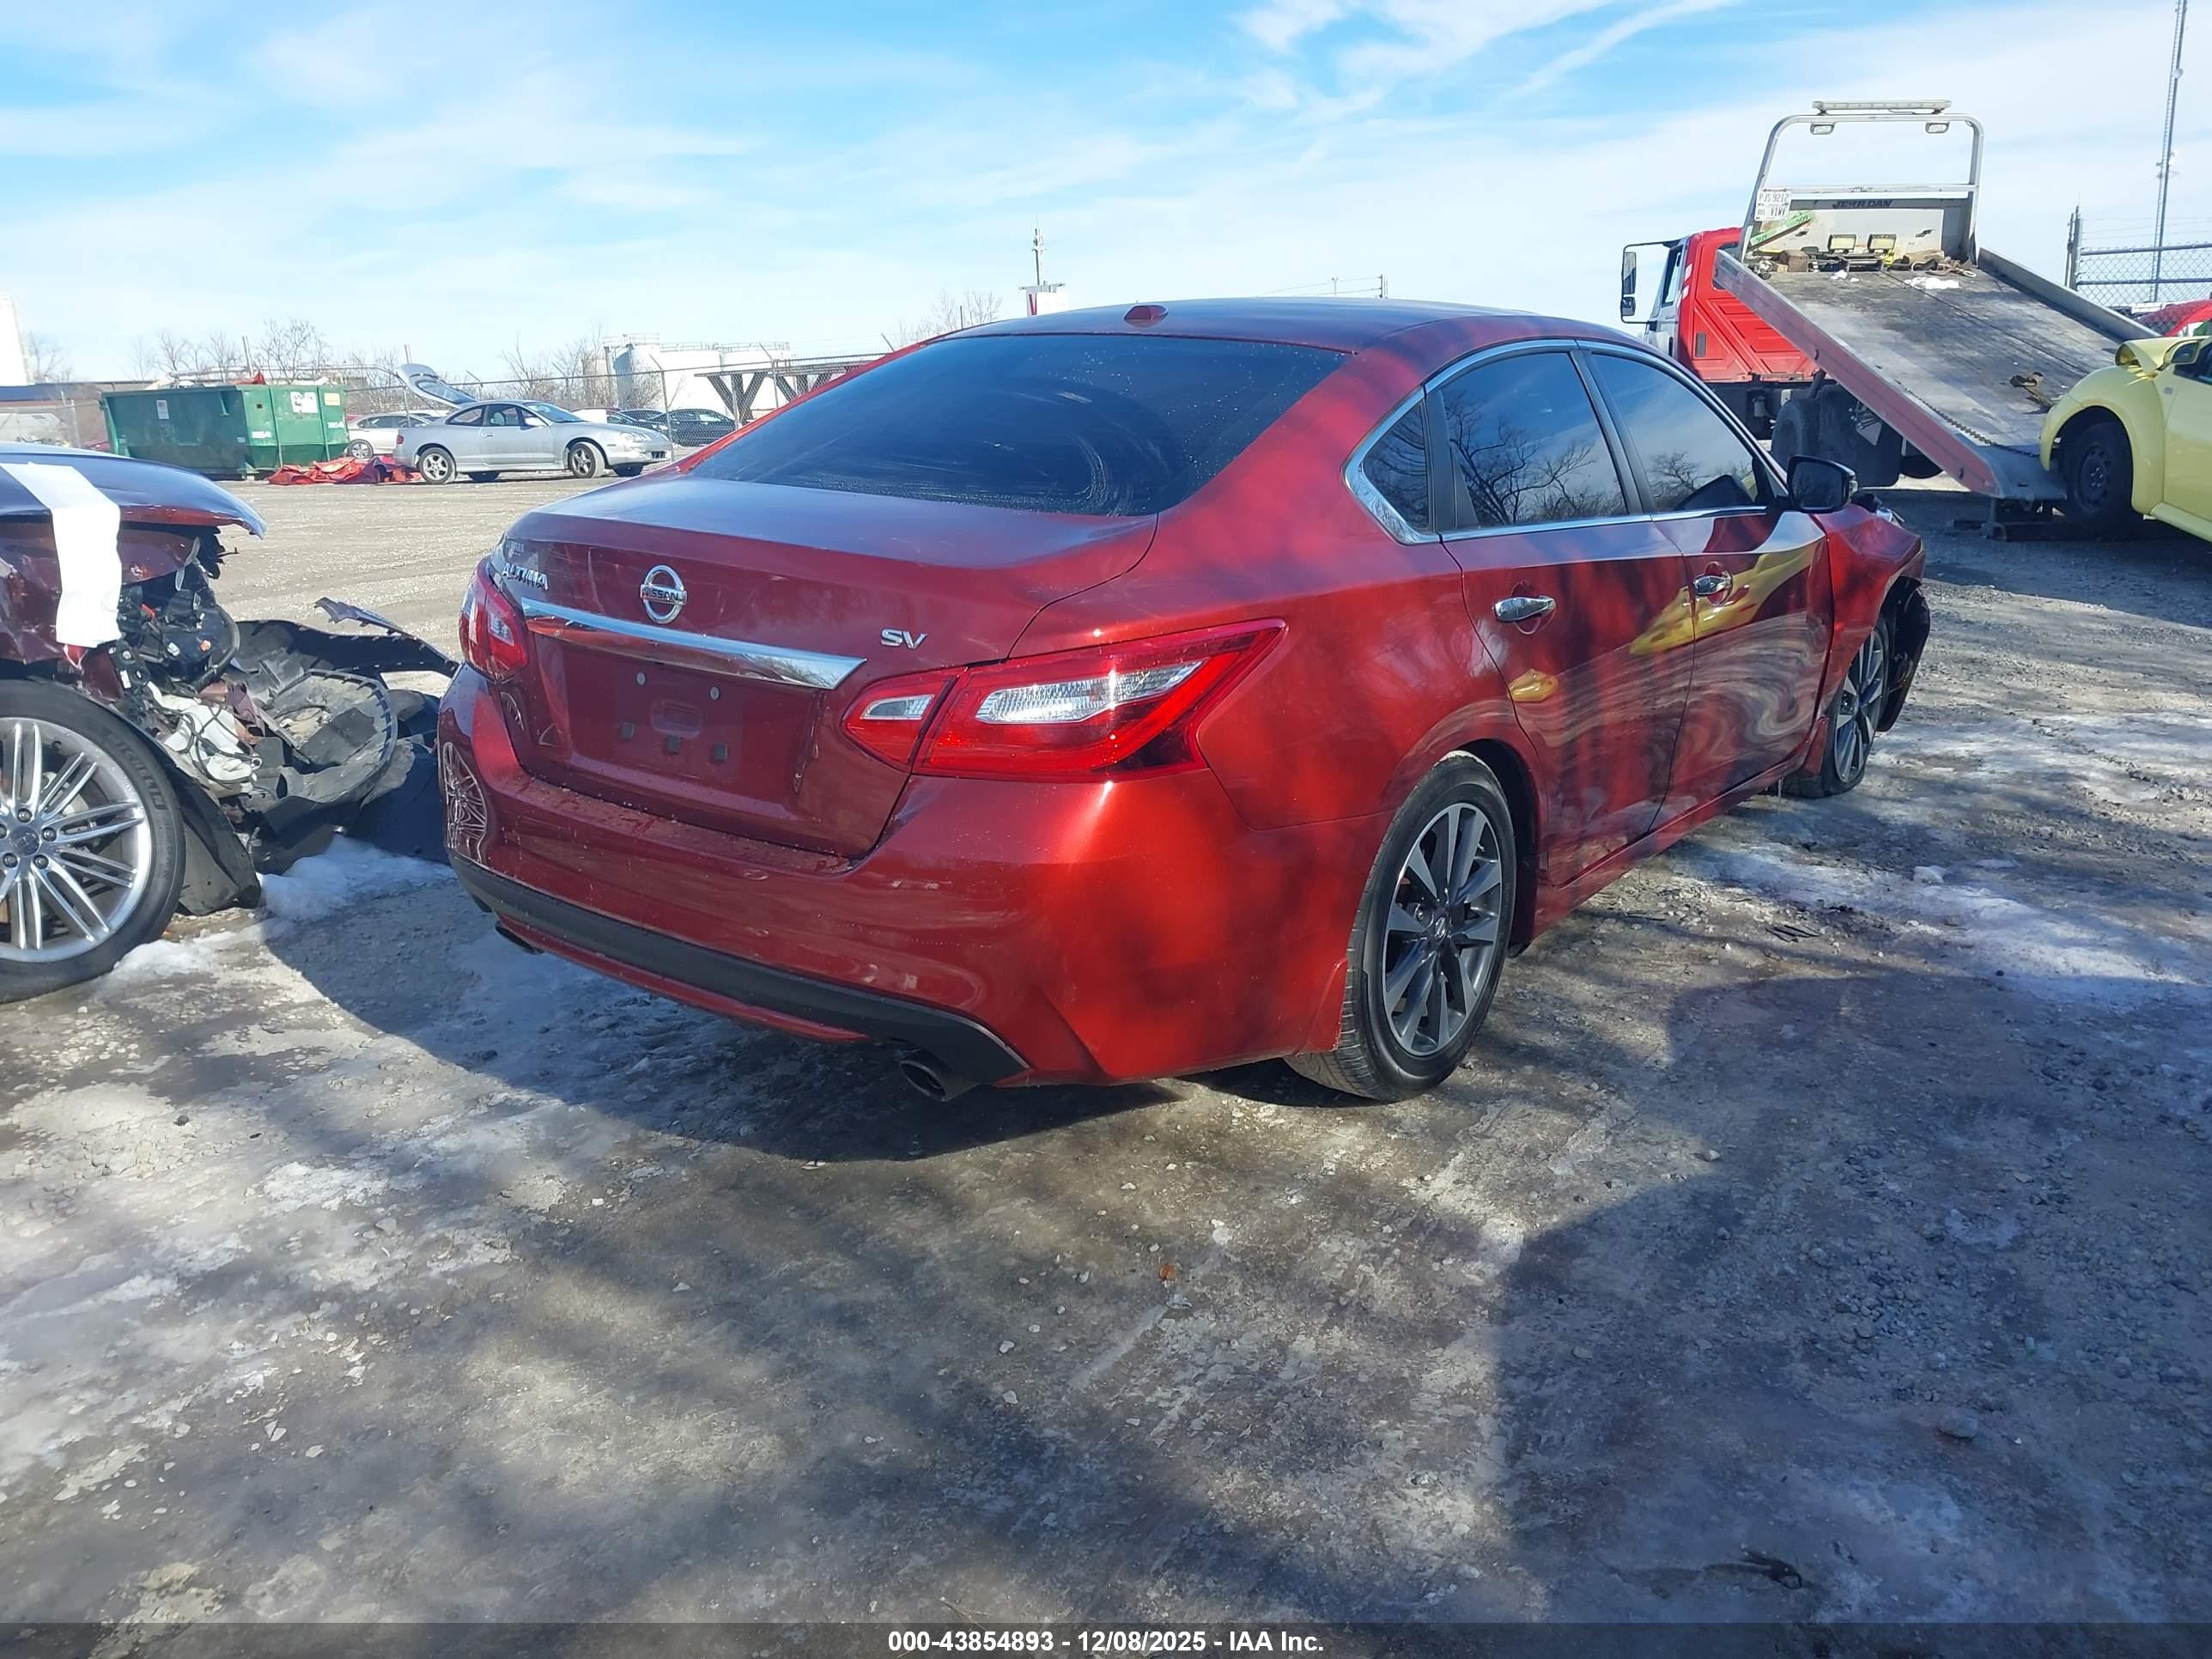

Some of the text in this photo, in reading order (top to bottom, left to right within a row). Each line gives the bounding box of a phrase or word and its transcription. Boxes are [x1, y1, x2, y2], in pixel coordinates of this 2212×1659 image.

[501, 562, 549, 591] ALTIMA
[642, 586, 679, 602] NISSAN
[879, 628, 927, 649] SV
